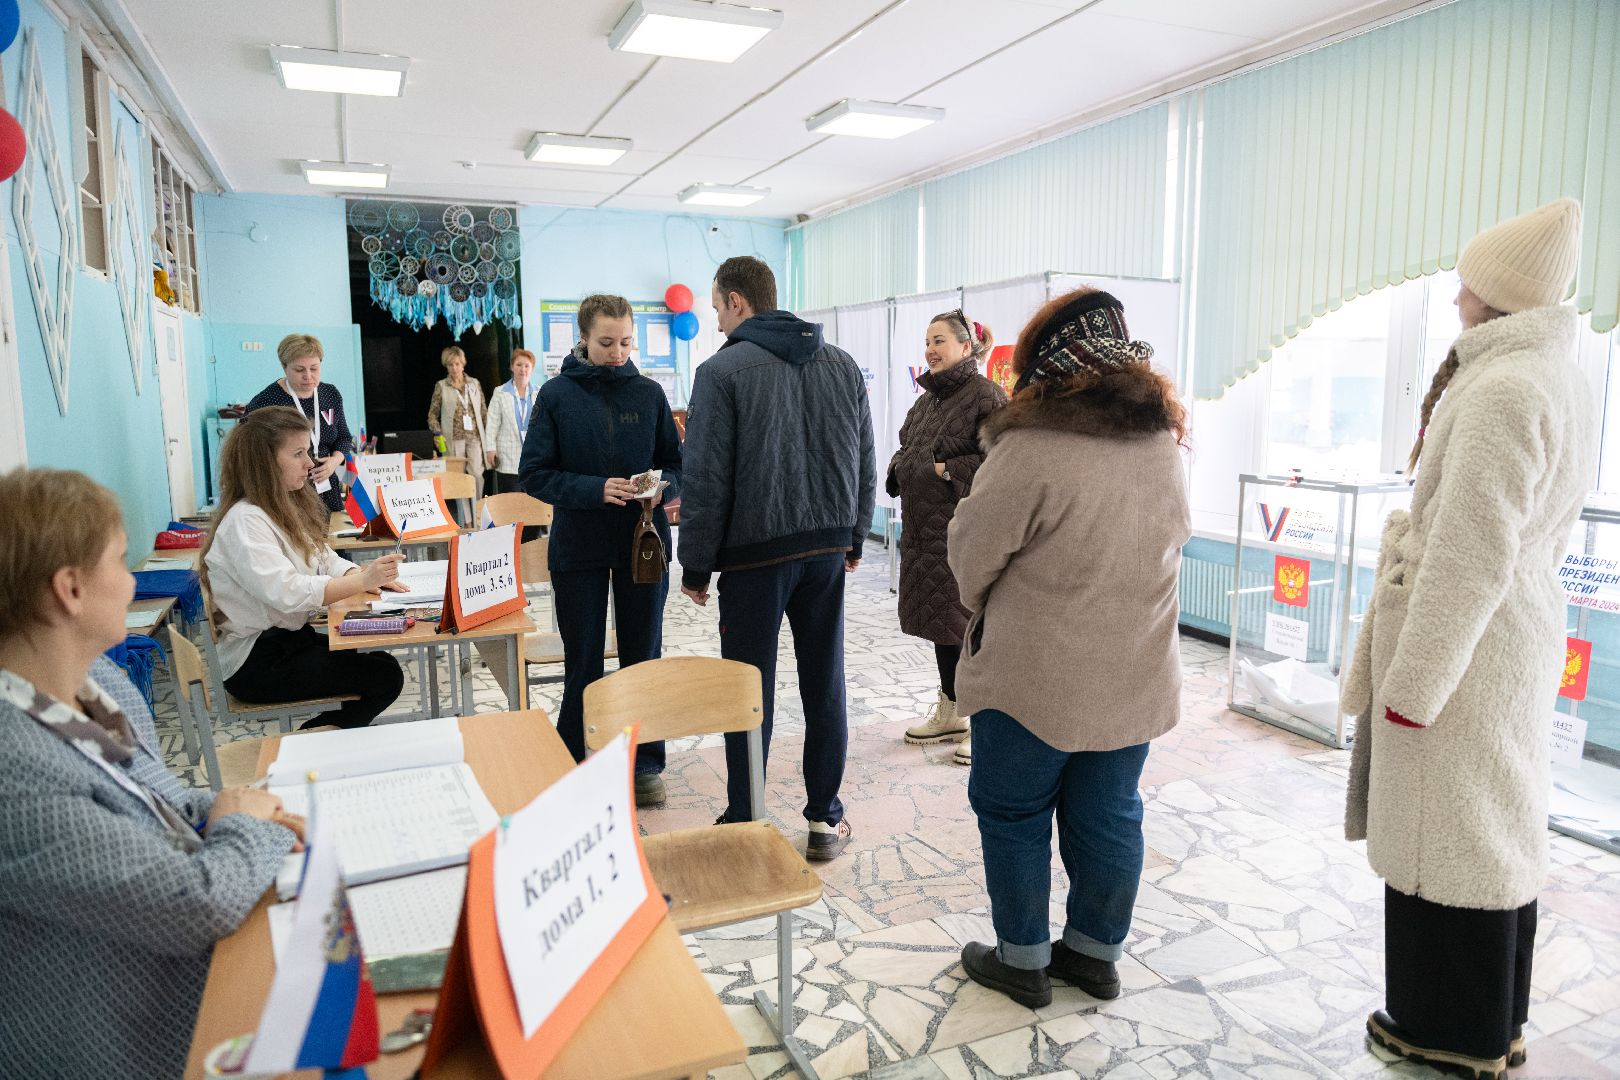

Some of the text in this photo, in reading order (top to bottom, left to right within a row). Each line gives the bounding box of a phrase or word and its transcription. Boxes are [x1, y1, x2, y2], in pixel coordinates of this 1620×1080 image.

[367, 466, 394, 475] вартал
[391, 494, 432, 508] Квартал 2
[429, 507, 435, 516] 8
[1284, 528, 1314, 541] РОССИИ
[465, 553, 509, 576] Квартал 2
[1565, 554, 1618, 570] ВЫБОРЫ
[1558, 566, 1620, 585] ПРЕЗИДЕН
[464, 584, 486, 600] дома
[508, 573, 513, 586] 6
[1561, 581, 1599, 594] ОССИИ
[1569, 595, 1598, 607] МАРТА
[522, 804, 615, 909] Квартал 2
[538, 896, 584, 960] дома
[608, 852, 618, 882] 2
